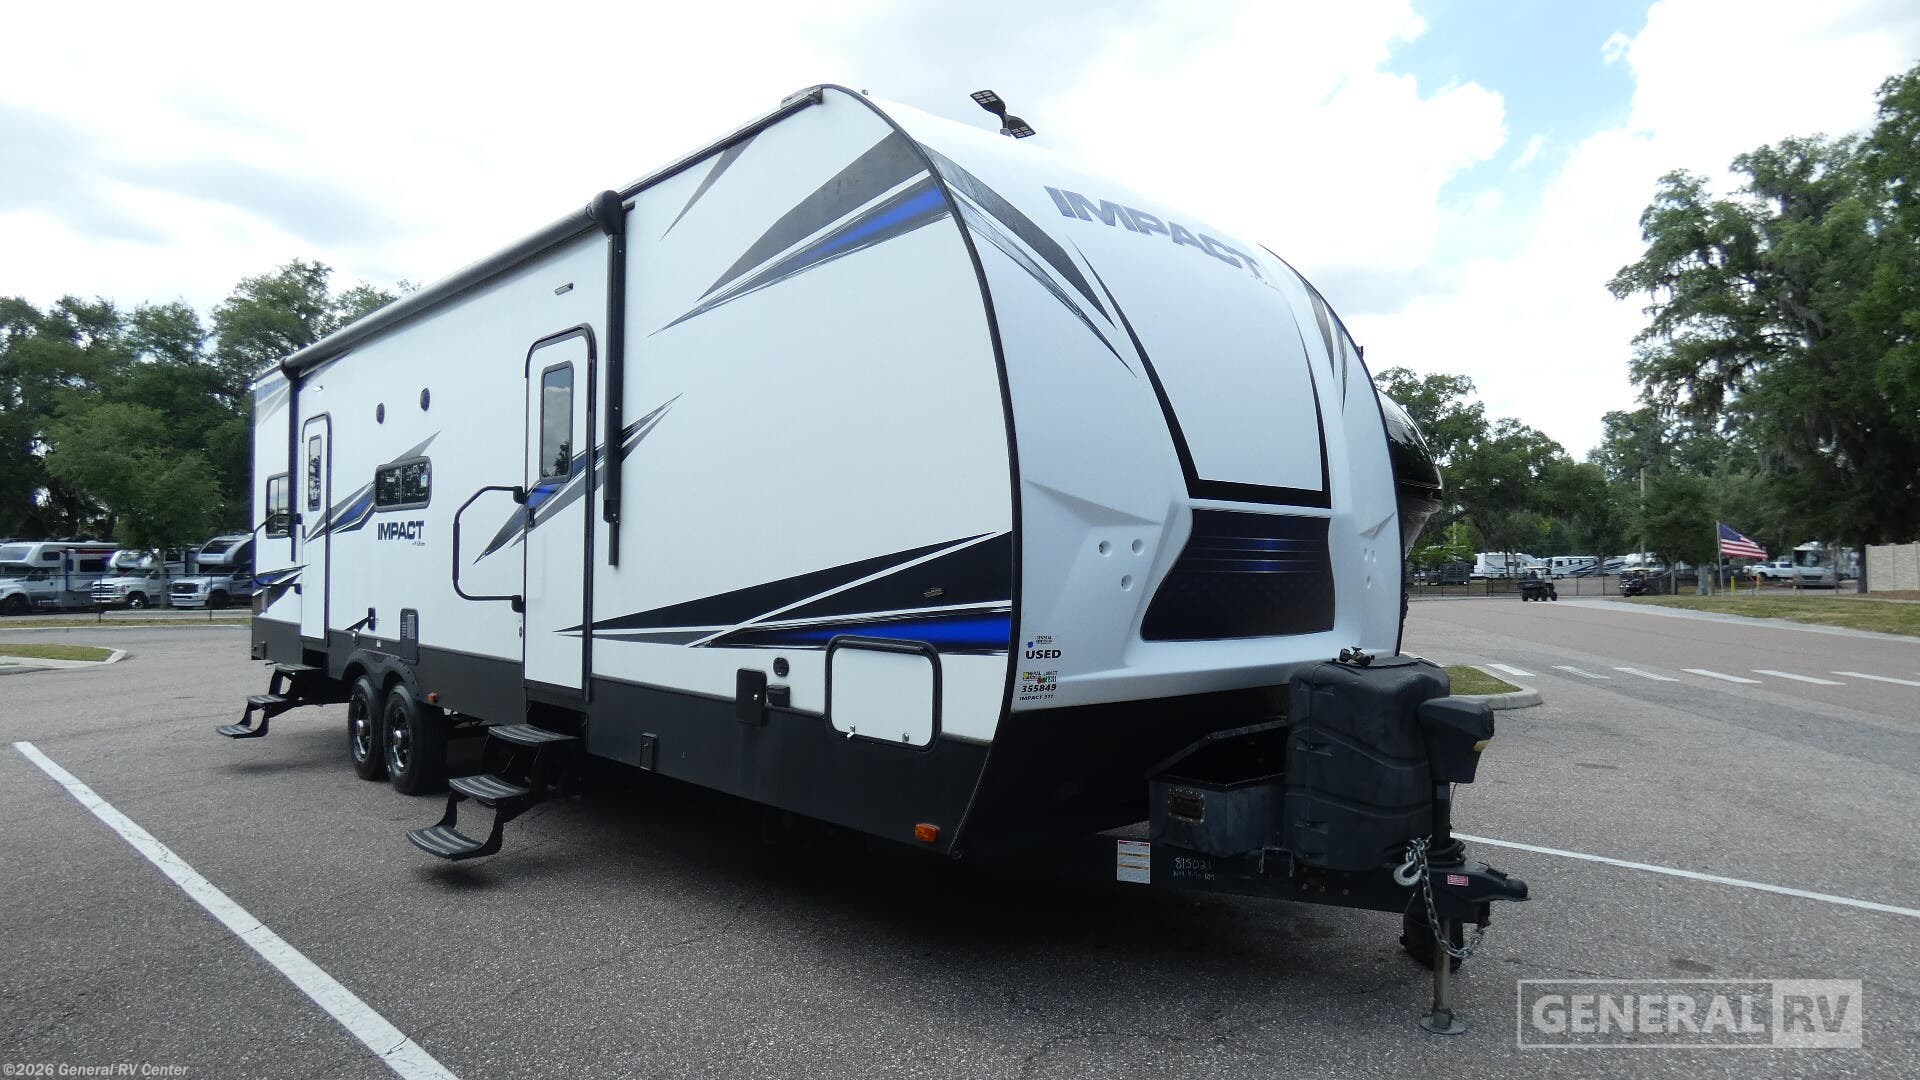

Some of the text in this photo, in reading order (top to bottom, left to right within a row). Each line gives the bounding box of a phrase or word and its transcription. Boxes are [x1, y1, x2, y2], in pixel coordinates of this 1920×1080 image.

[1043, 185, 1263, 279] IMPACT
[378, 520, 425, 541] IMPACT
[1026, 650, 1062, 660] USED
[1021, 684, 1057, 693] 355849
